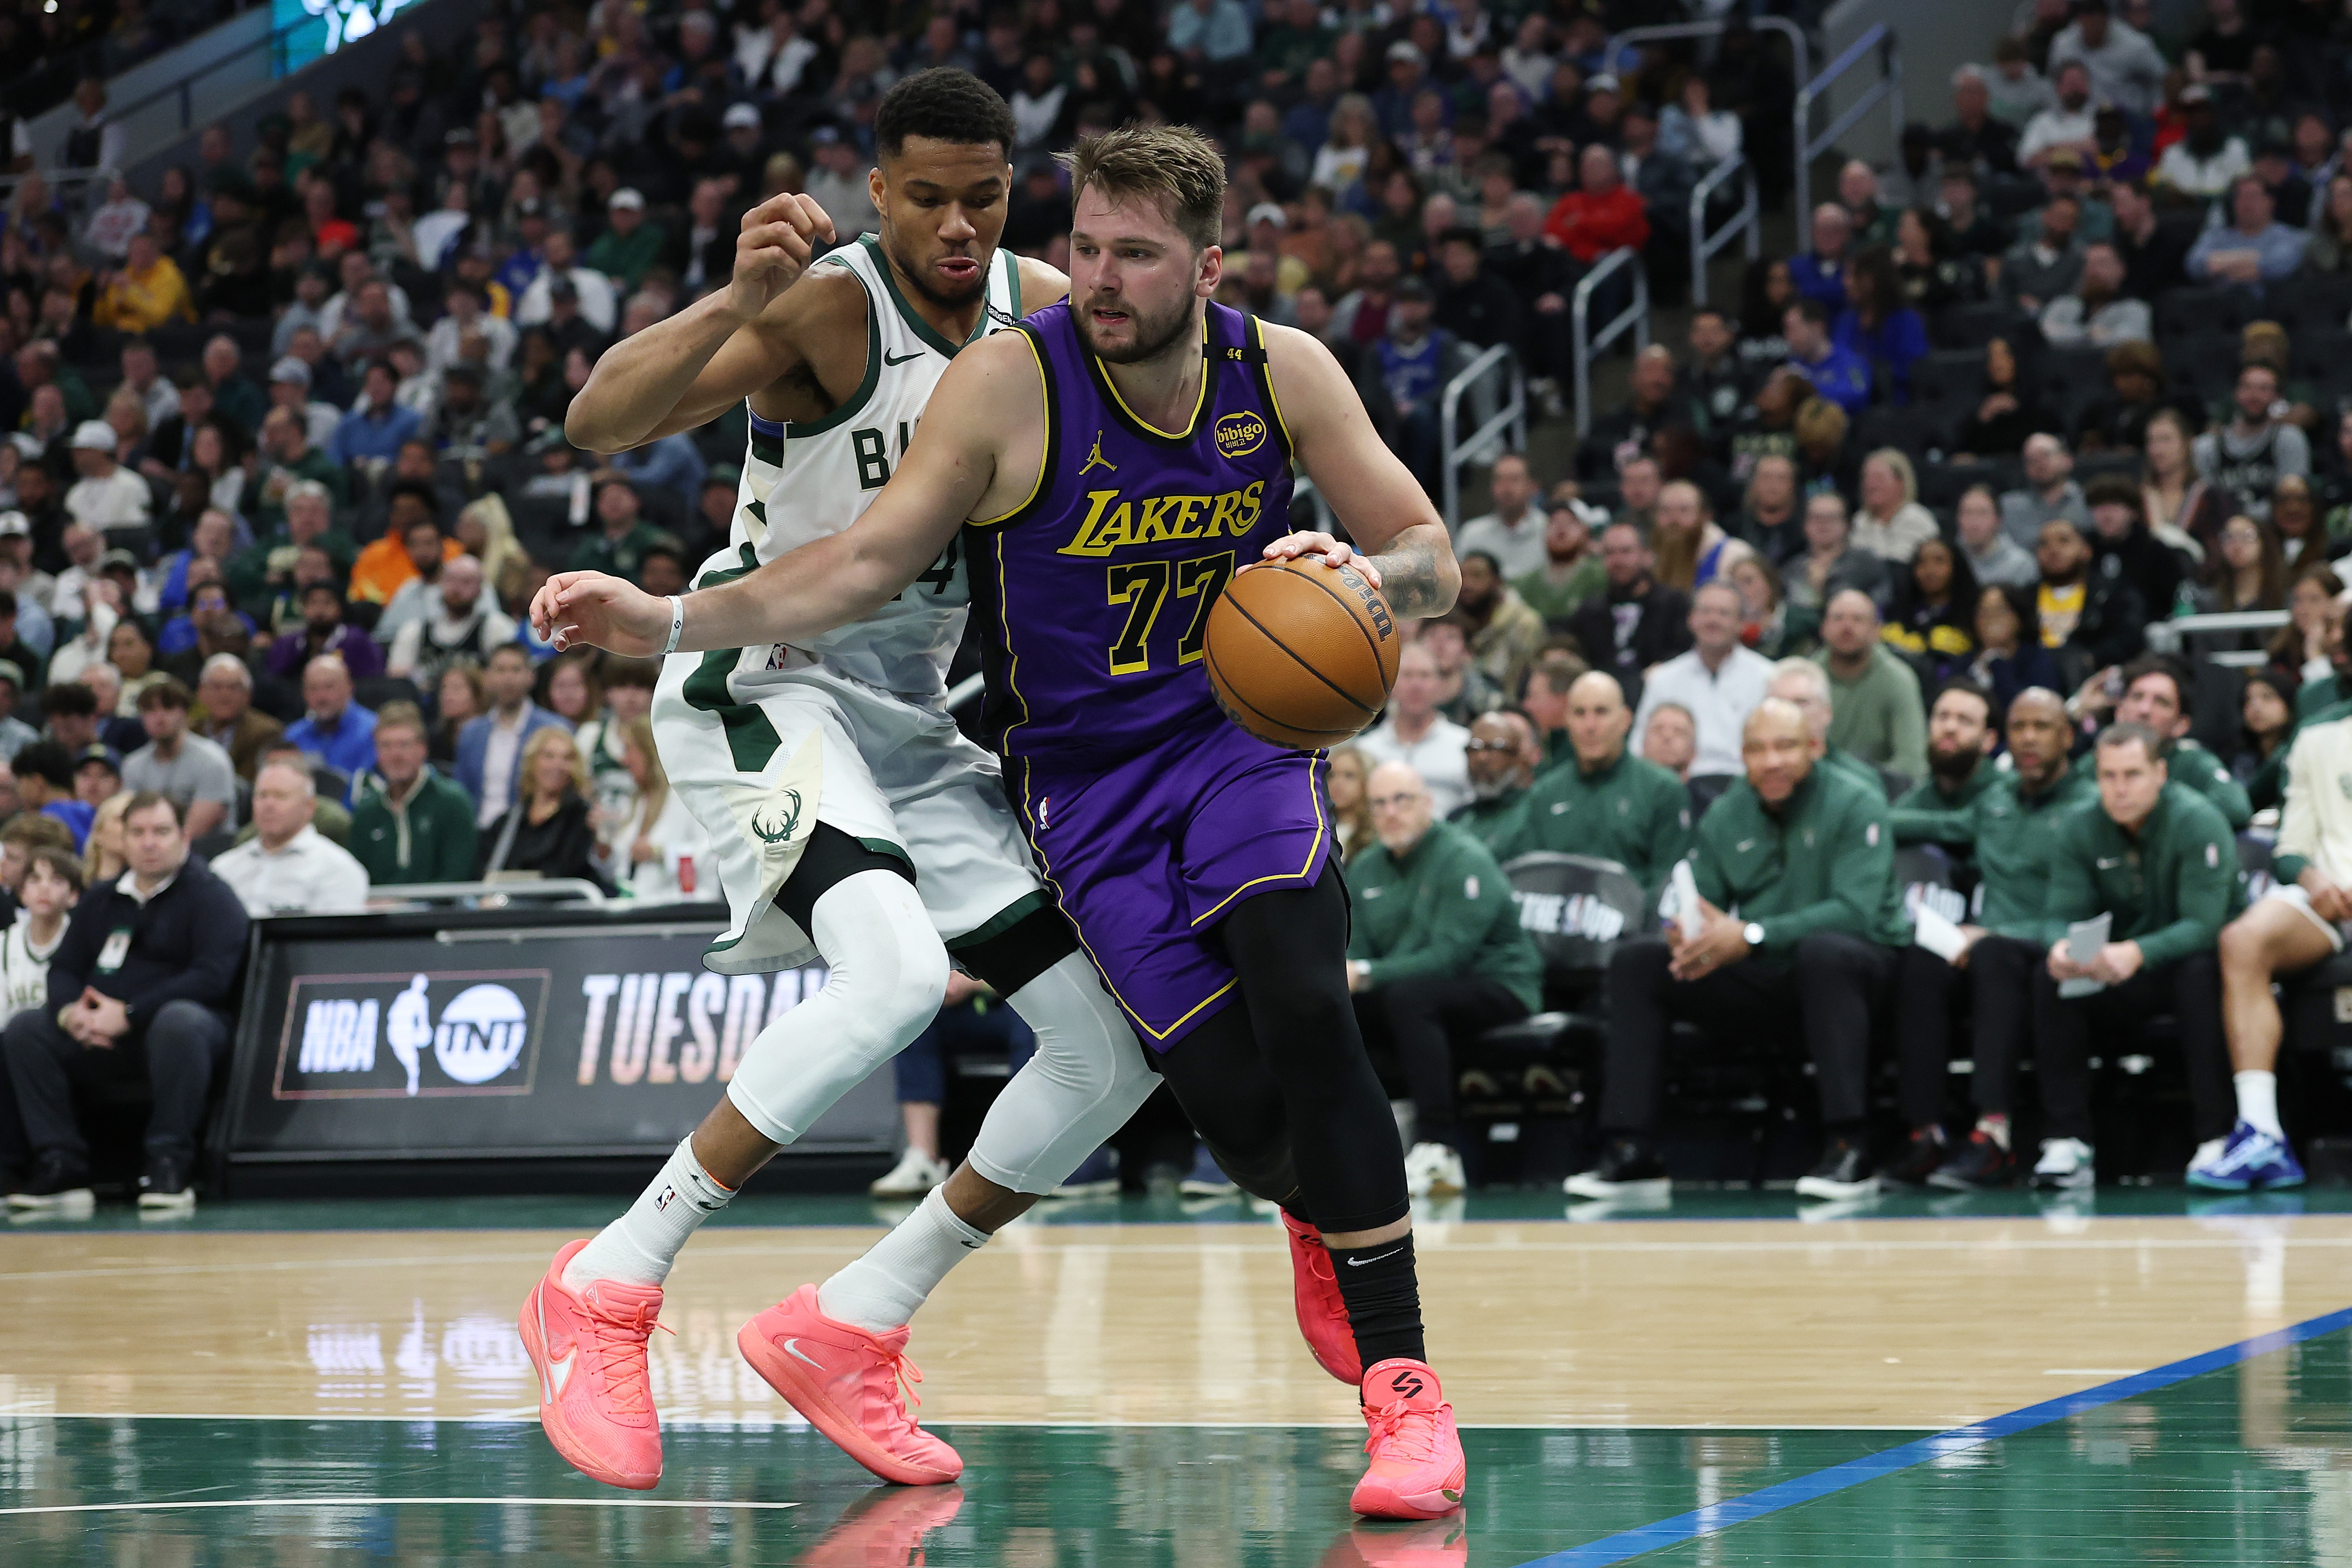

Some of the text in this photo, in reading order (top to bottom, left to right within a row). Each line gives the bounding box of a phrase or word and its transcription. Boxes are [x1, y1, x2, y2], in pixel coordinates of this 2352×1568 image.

[987, 305, 1018, 325] BRIDGEM
[1227, 348, 1242, 360] 44
[1216, 423, 1262, 443] bibigo
[1225, 438, 1246, 448] 비비고
[1056, 480, 1265, 557] LAKERS
[1107, 549, 1236, 676] 77
[298, 997, 380, 1073] NBA
[576, 967, 833, 1086] TUESD
